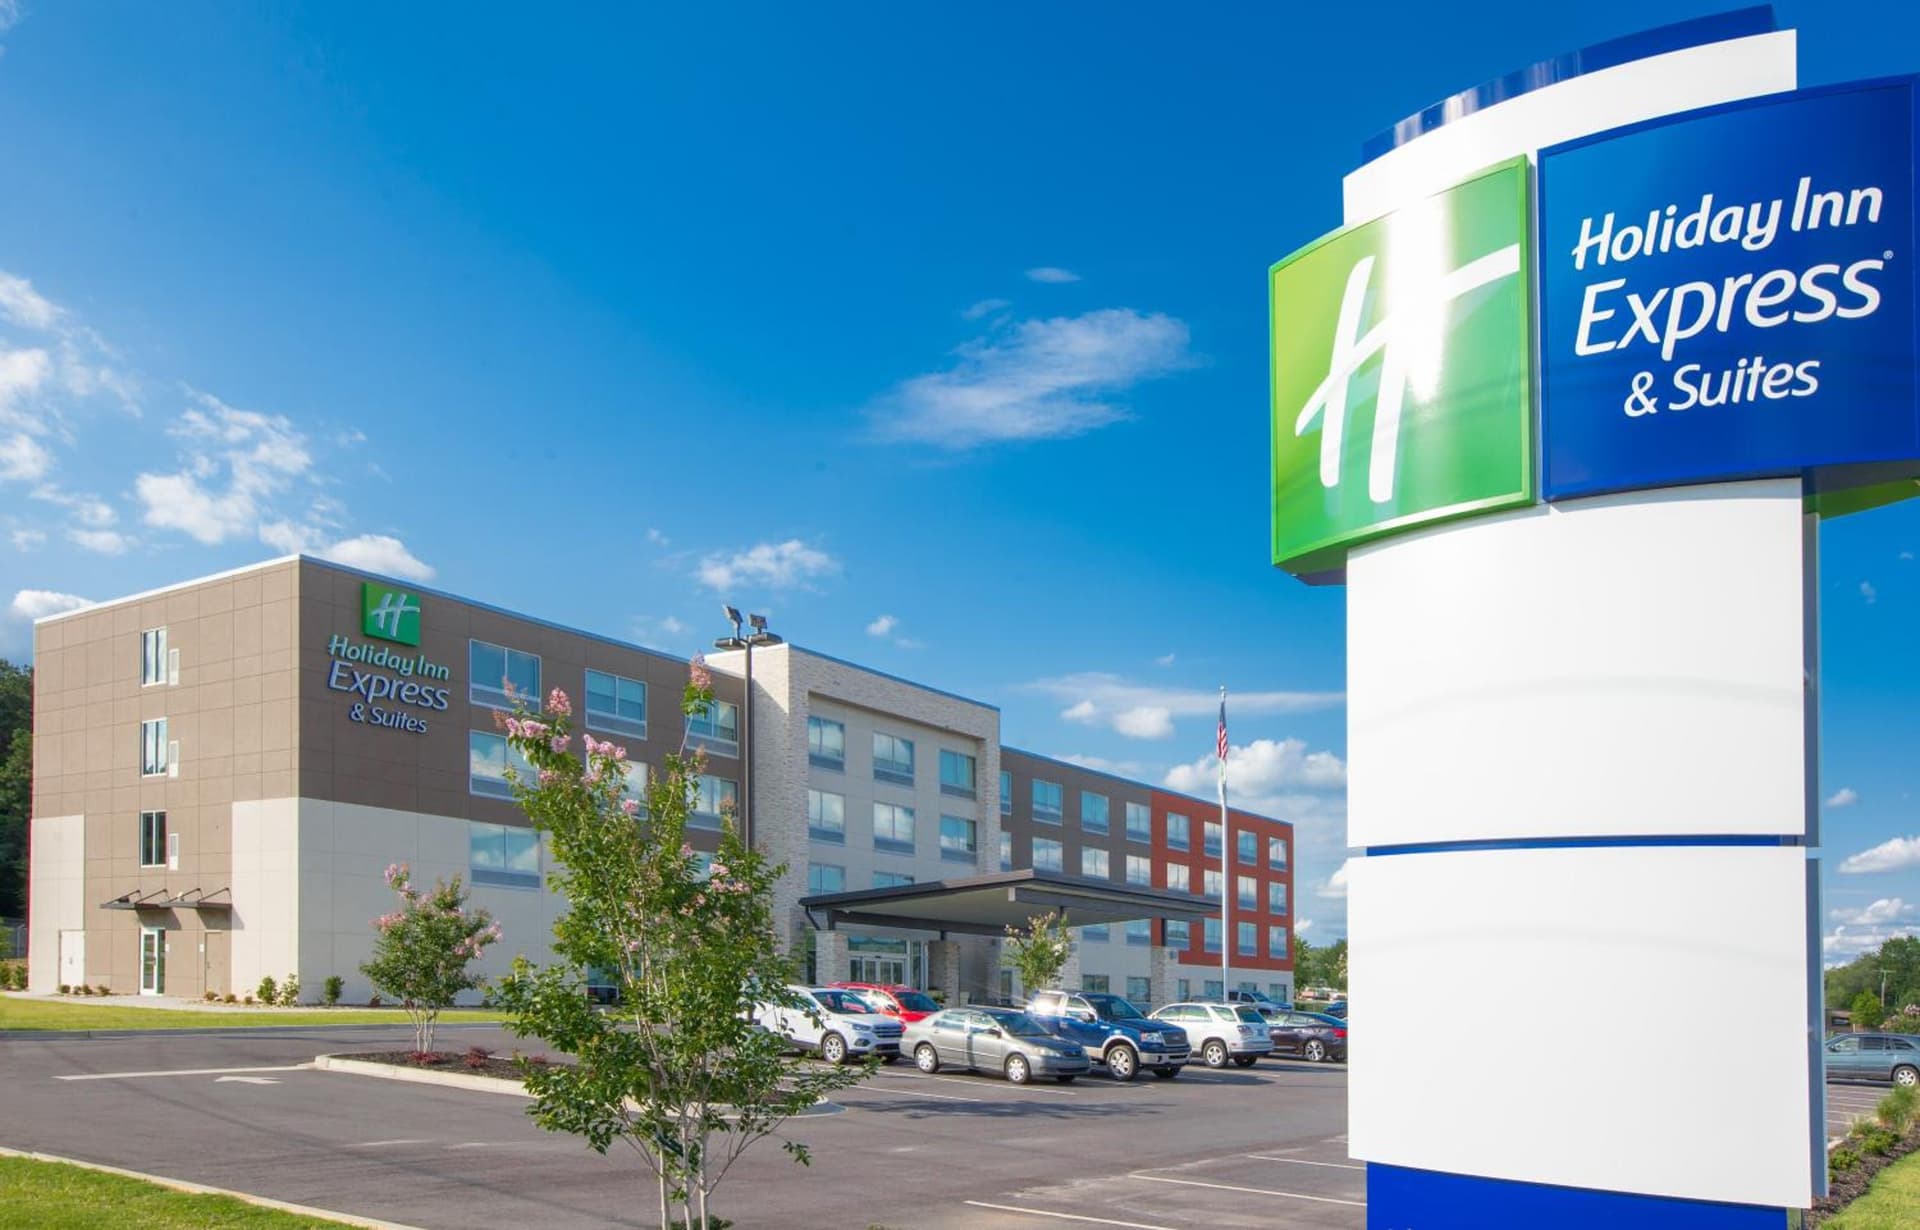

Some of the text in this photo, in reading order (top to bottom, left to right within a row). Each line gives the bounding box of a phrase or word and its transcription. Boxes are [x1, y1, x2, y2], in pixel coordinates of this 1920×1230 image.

[1571, 176, 1883, 271] Holiday Inn
[1623, 356, 1821, 418] & Suites
[328, 634, 449, 680] Holiday Inn
[328, 659, 450, 711] Express
[349, 702, 428, 734] & Suites
